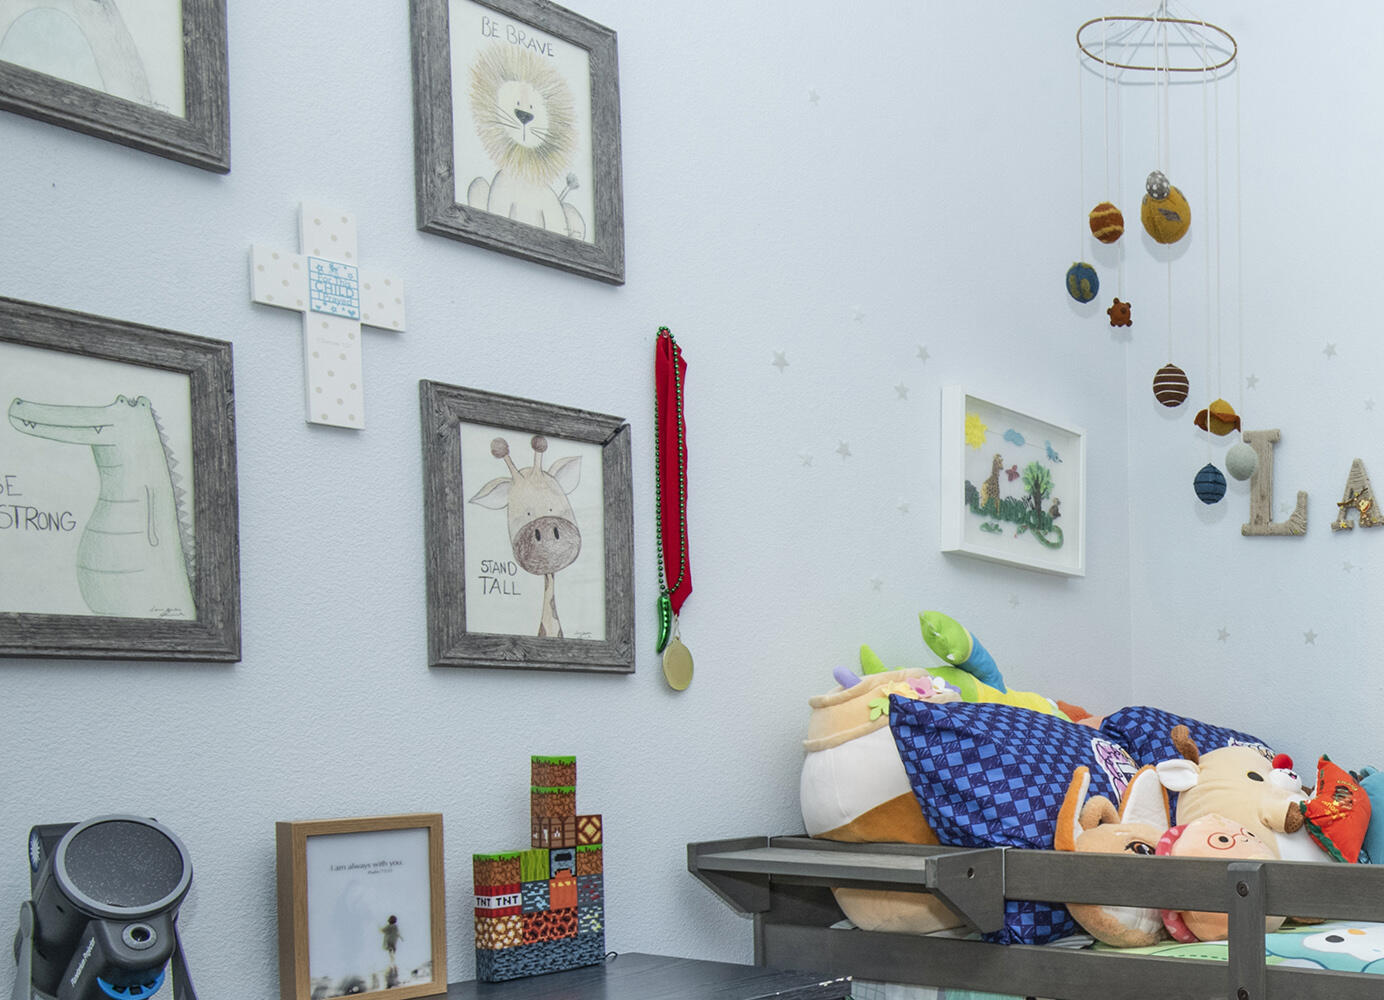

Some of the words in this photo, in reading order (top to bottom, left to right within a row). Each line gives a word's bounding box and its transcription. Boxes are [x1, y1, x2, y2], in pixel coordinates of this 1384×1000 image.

[481, 16, 500, 39] BE
[506, 23, 554, 57] BRAVE
[314, 279, 354, 299] CHILD
[481, 560, 518, 576] STAND
[478, 576, 522, 596] TALL
[476, 897, 491, 907] TNT
